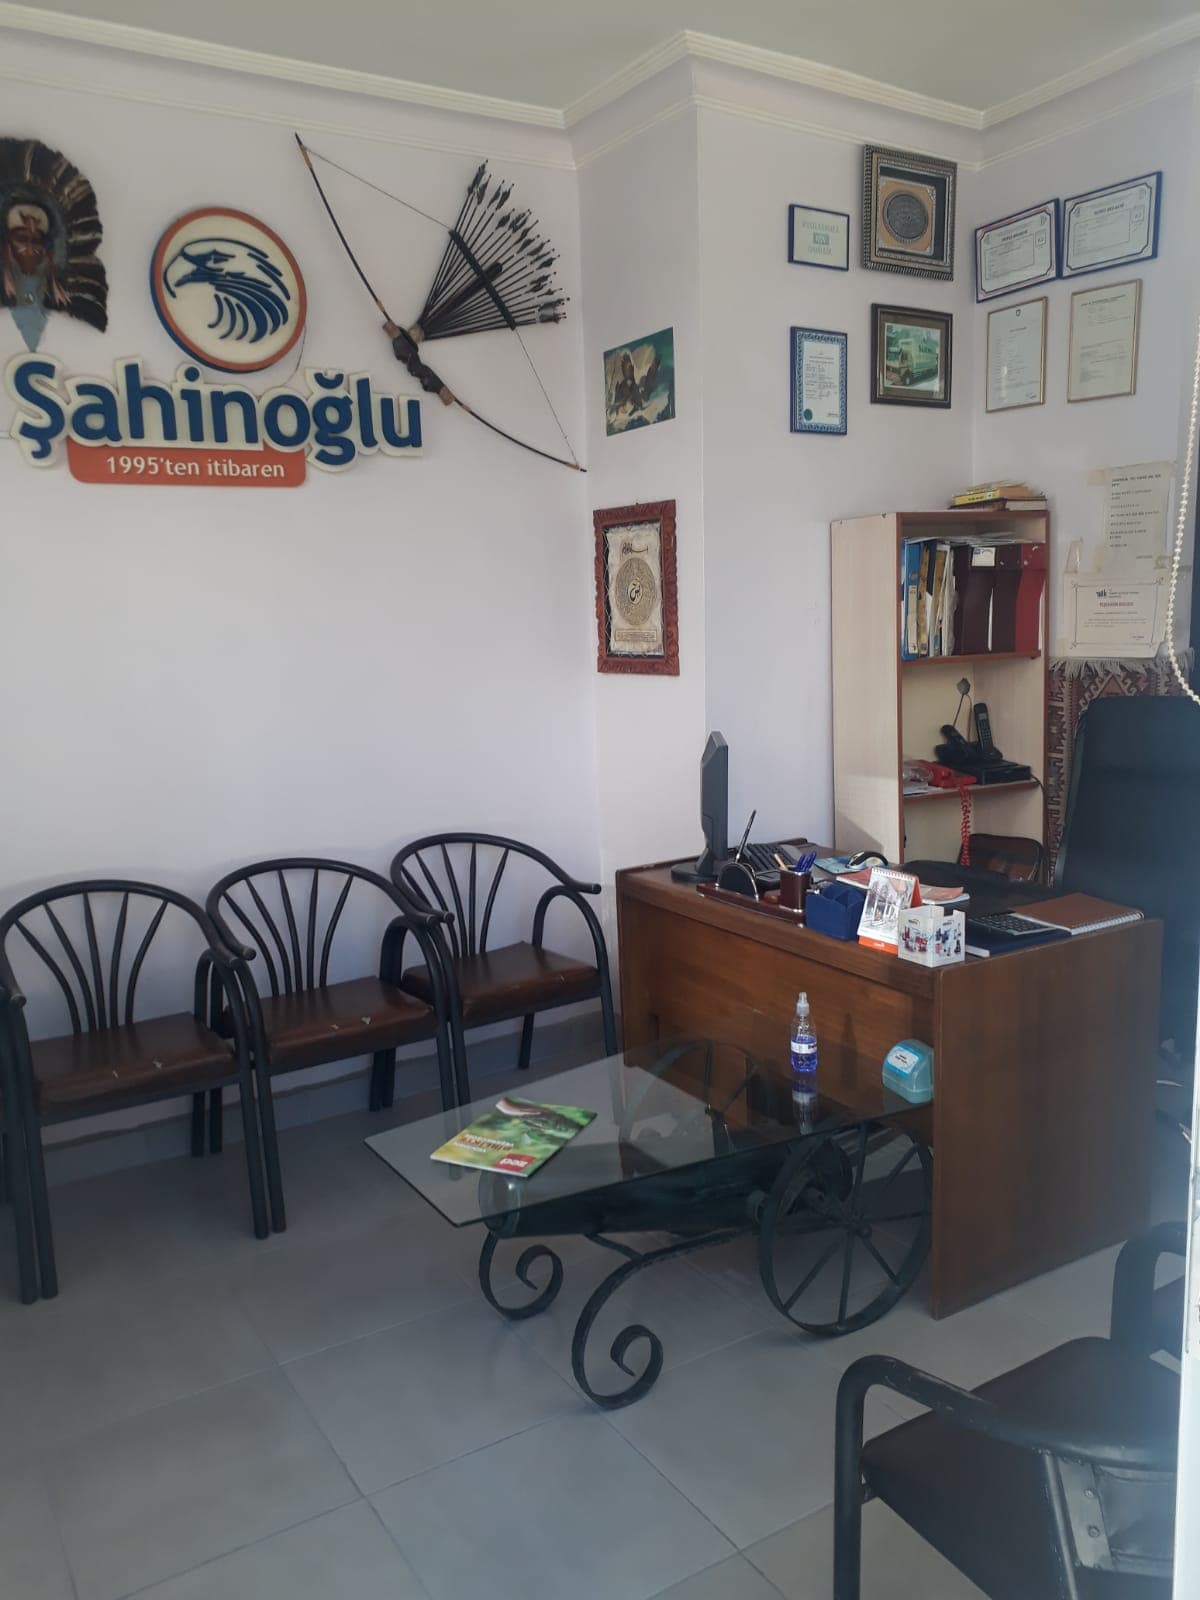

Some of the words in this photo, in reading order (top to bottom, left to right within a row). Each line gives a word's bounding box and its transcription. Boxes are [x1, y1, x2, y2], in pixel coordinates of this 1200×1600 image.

[13, 360, 423, 465] Şahinoğlu
[106, 455, 200, 476] 1995'ten
[207, 458, 285, 477] itibaren
